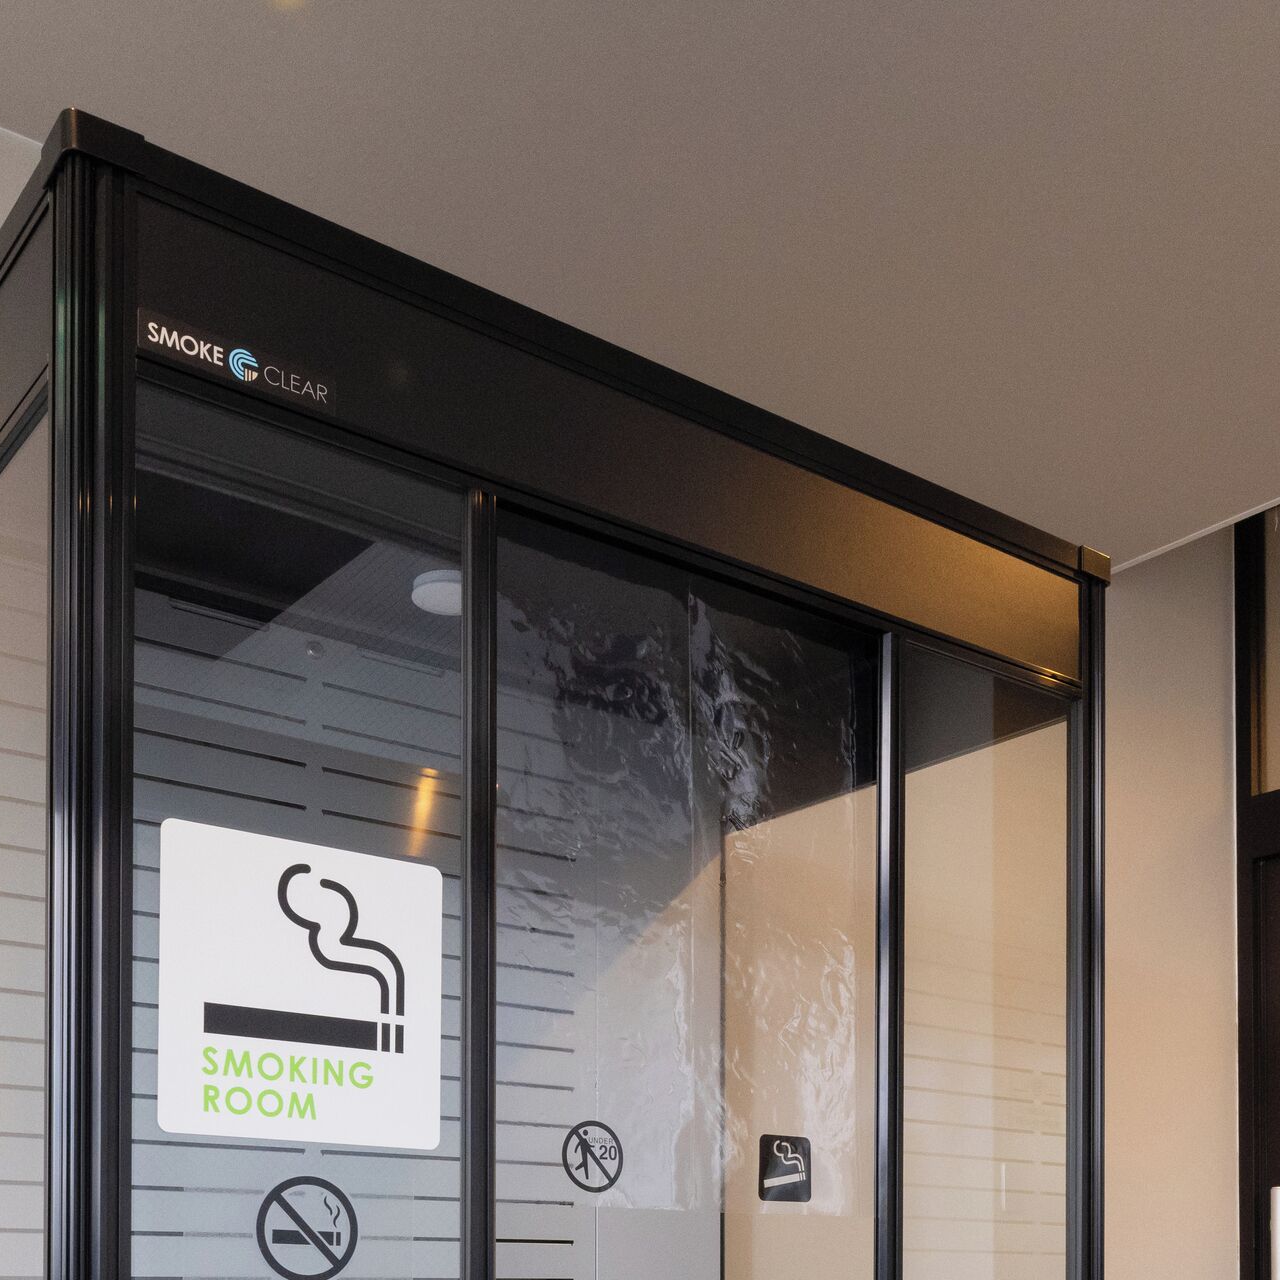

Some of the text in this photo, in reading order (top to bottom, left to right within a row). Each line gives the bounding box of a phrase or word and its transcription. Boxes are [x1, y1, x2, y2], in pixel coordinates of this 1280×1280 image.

[147, 322, 328, 404] SMOKE CLEAR
[201, 1046, 374, 1089] SMOKING
[202, 1084, 317, 1120] ROOM
[588, 1137, 614, 1145] UNDER
[599, 1145, 617, 1160] 20
